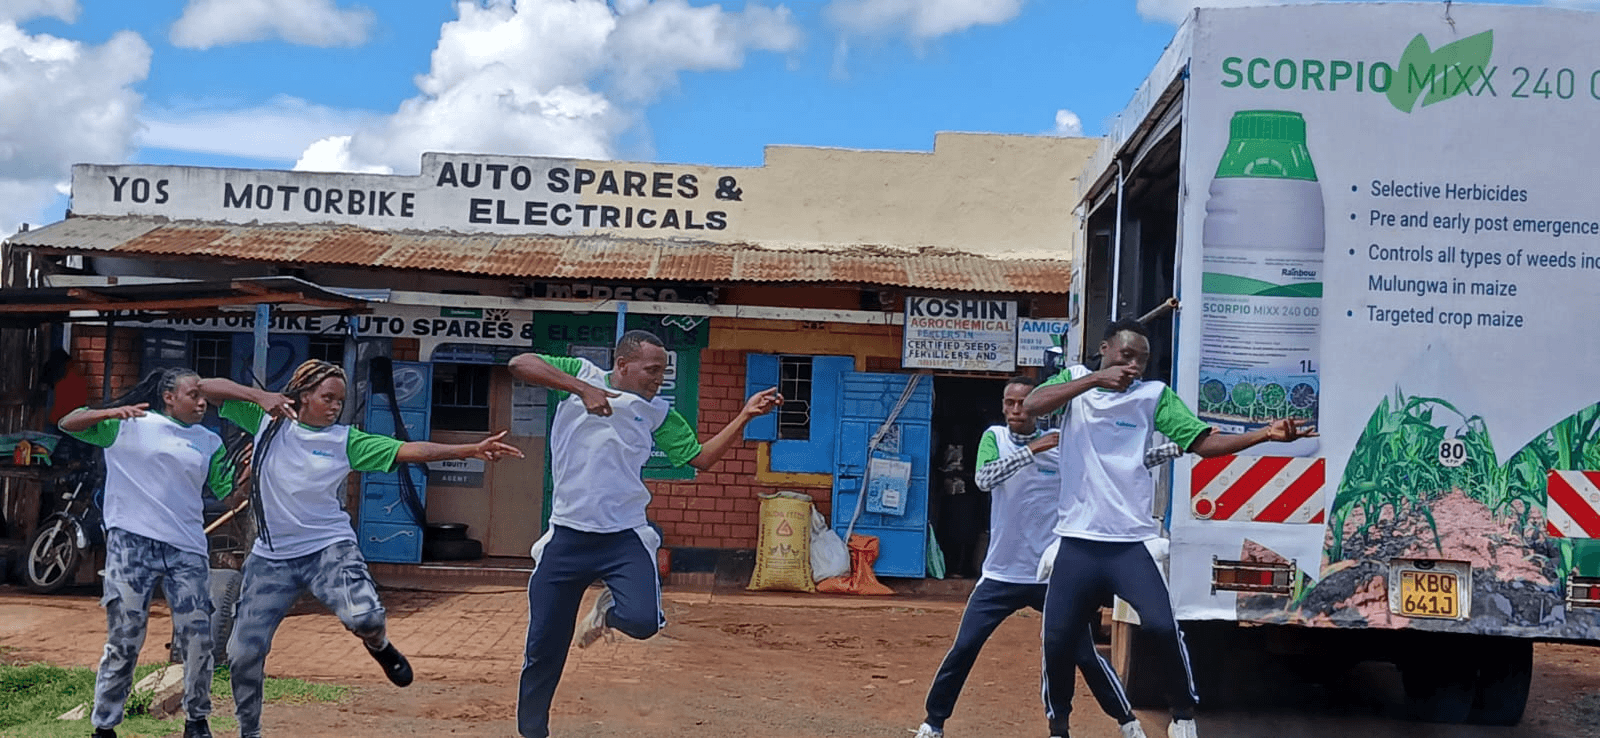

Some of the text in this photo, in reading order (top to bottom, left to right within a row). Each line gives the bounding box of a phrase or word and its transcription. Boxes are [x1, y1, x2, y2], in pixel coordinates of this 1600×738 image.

[1220, 56, 1392, 93] SCORPIO
[1408, 62, 1497, 97] MIXX
[1511, 67, 1575, 100] 240
[437, 161, 744, 201] AUTO SPARES &
[1371, 180, 1528, 203] Selective Herbicides
[108, 176, 416, 218] YOS MOTORBIKE
[469, 198, 728, 231] ELECTRICALS
[1370, 210, 1599, 238] Pre and early post emergence
[1368, 244, 1442, 262] Controls
[1446, 246, 1456, 263] all
[1461, 249, 1502, 269] types
[1506, 248, 1522, 266] of
[1526, 250, 1576, 269] weeds
[1281, 268, 1317, 277] Rainbow
[1368, 274, 1517, 297] Mulungwa in maize
[909, 297, 1008, 320] KOSHIN
[1203, 302, 1320, 317] SCORPIO MIXX 240 OD
[1367, 305, 1523, 328] Targeted crop maize
[335, 316, 404, 335] AUTO
[412, 318, 514, 339] SPARES
[910, 318, 1012, 332] AGROCHEMICAL
[908, 340, 998, 351] CERTIFIED SEEDS
[975, 352, 997, 360] AND
[1300, 360, 1317, 373] 1L
[1440, 442, 1464, 459] 80
[1415, 573, 1452, 594] KBQ
[1405, 595, 1452, 614] 641J
